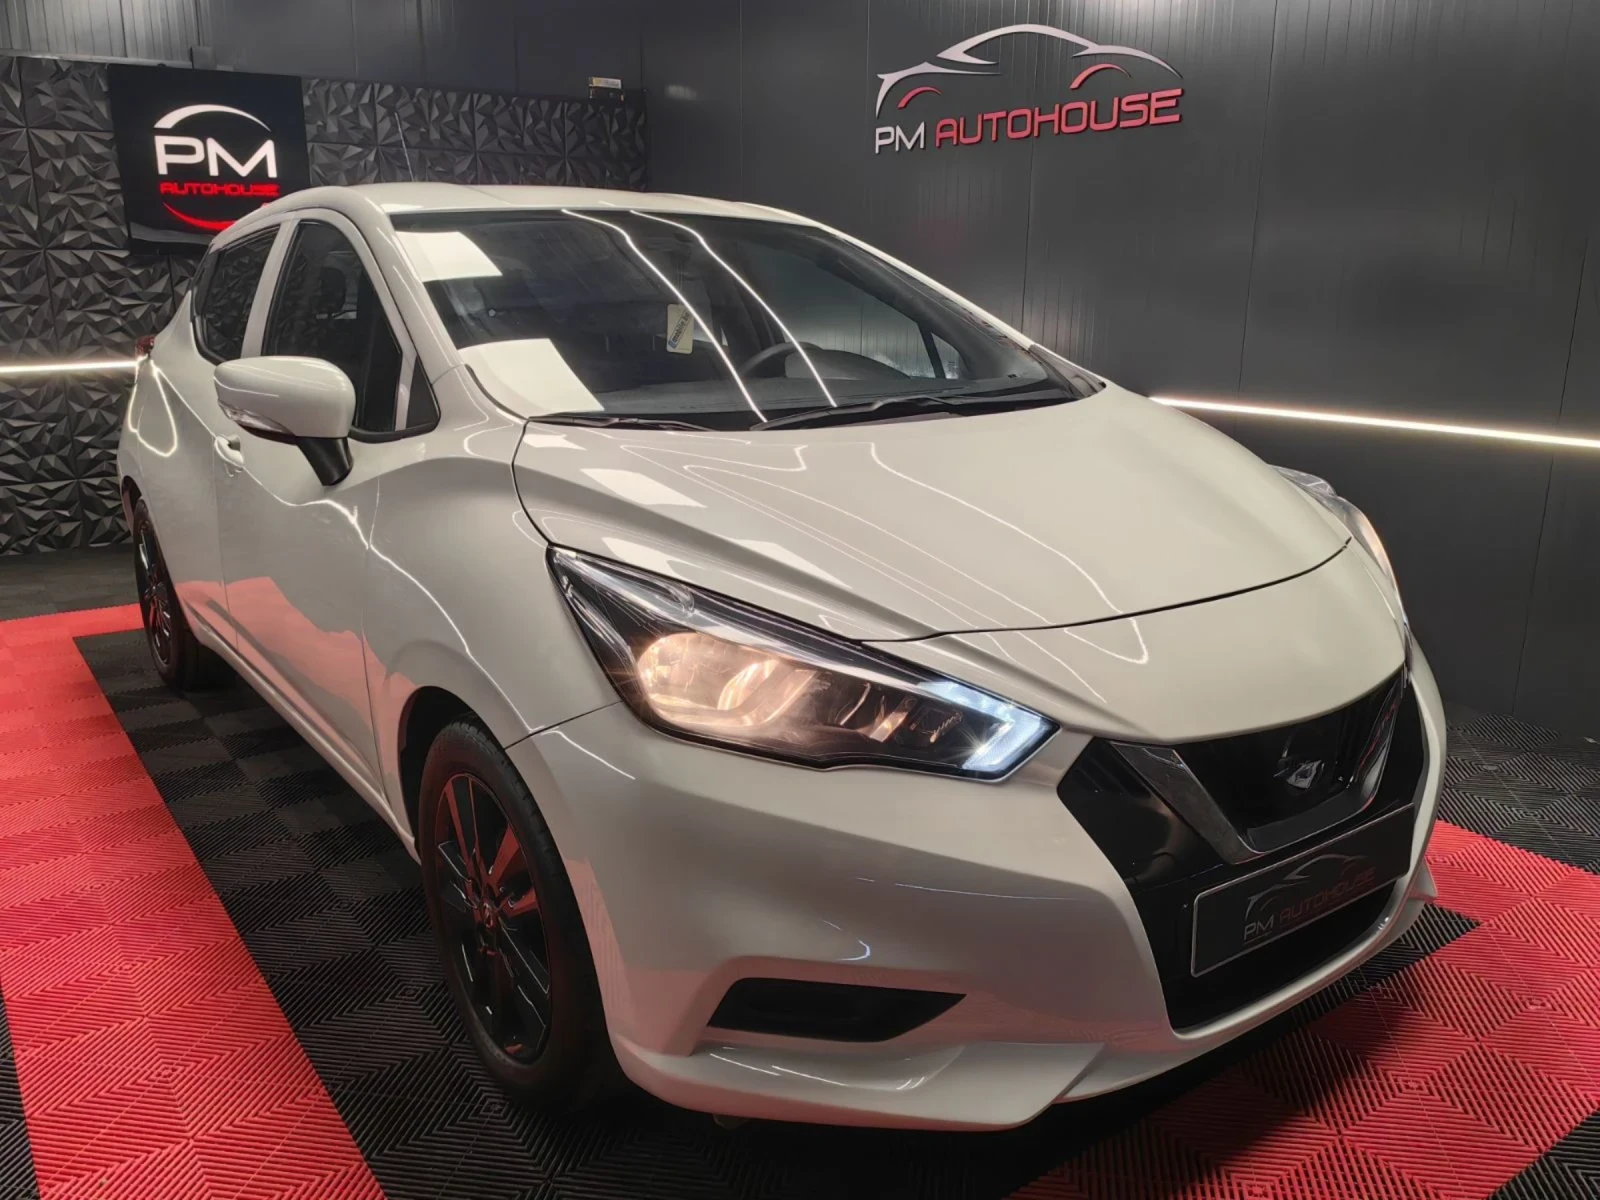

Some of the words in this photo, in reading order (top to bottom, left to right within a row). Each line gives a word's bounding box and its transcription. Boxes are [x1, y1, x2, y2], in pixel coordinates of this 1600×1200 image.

[874, 120, 925, 154] PM
[934, 88, 1183, 148] AUTOHOUSE
[154, 135, 278, 178] PM
[159, 182, 279, 196] AUTOHOUSE
[1243, 914, 1275, 941] PM
[1279, 866, 1376, 923] AUTOHOUSE
